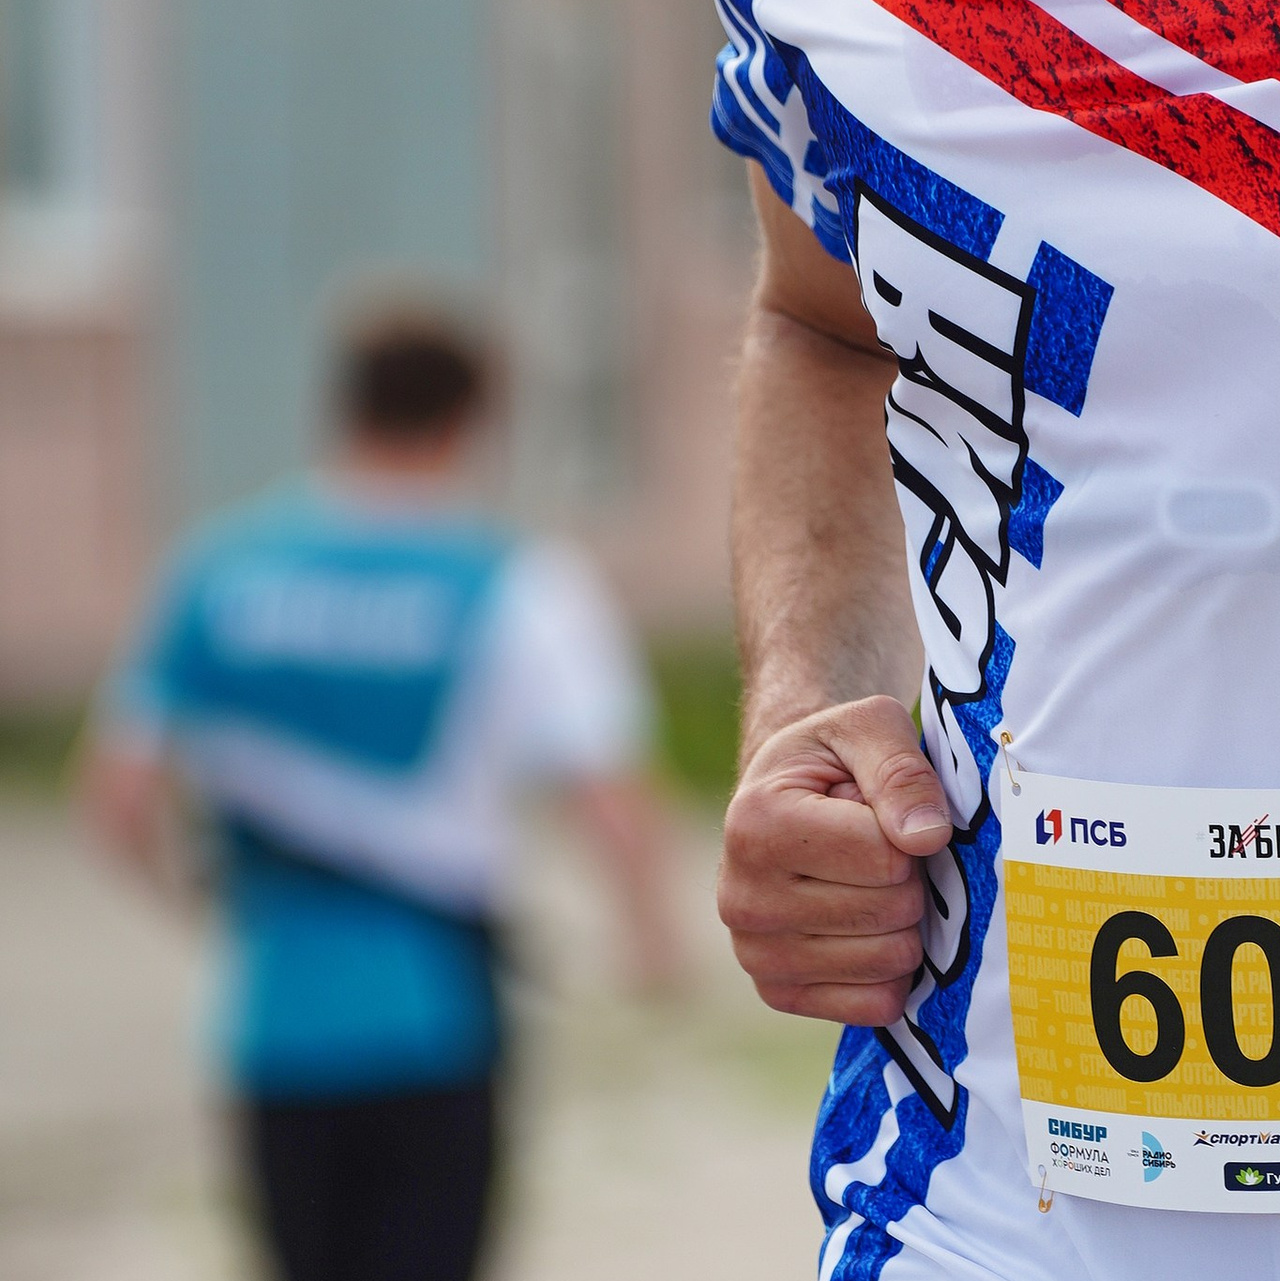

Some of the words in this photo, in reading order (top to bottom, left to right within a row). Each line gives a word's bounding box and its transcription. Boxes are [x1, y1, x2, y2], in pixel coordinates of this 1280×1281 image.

[1070, 817, 1127, 847] ПСБ
[1195, 879, 1267, 900] БЕГОВАЯ
[1065, 899, 1081, 922] НА
[1033, 924, 1054, 949] БЕГ
[1067, 928, 1097, 954] СЕБ
[1027, 954, 1069, 983] ДАВНО
[1065, 1021, 1099, 1048] ЛЮБ
[1205, 1093, 1269, 1118] НАЧАЛО
[1048, 1118, 1107, 1142] СИБУР
[1050, 1142, 1109, 1164] ФОРМУЛА
[1142, 1150, 1172, 1160] РАДИО
[1142, 1159, 1176, 1169] СИБИРЬ
[1094, 1165, 1111, 1177] ДЕЛ
